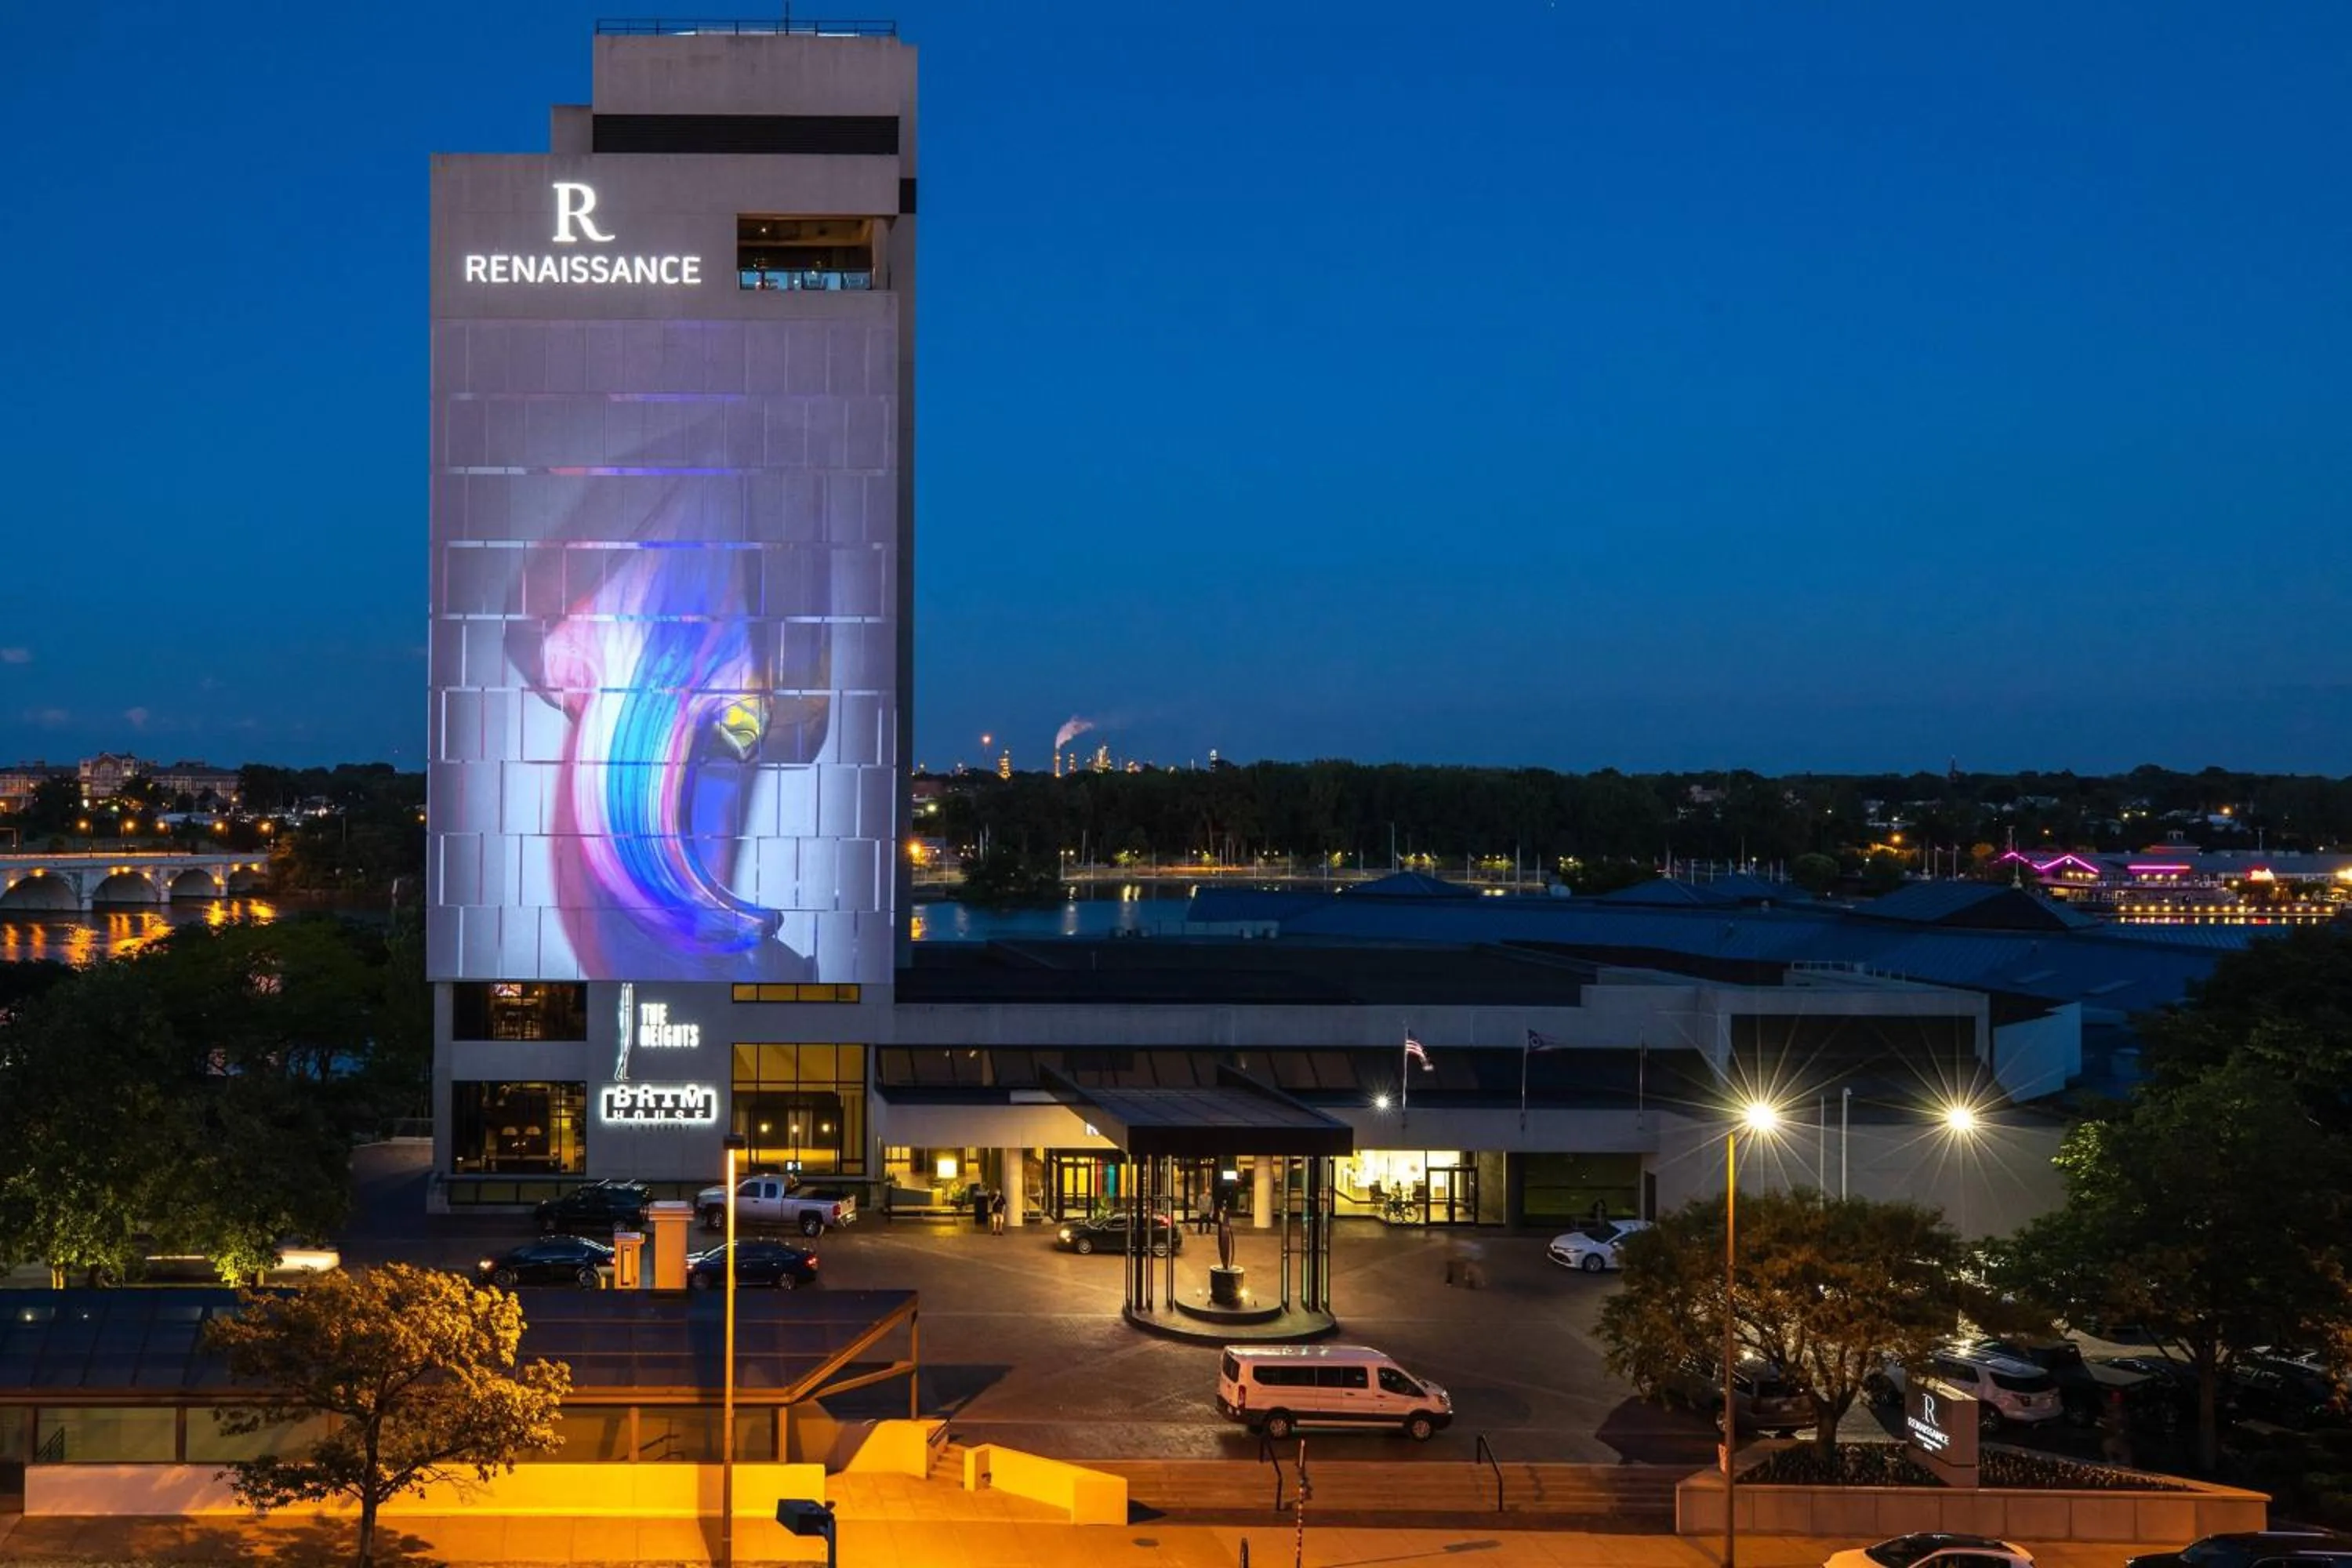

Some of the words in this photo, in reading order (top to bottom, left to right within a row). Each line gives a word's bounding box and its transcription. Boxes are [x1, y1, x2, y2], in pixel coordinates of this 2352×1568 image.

[552, 183, 615, 242] R
[466, 254, 702, 284] RENAISSANCE
[641, 1003, 667, 1025] THE
[639, 1024, 699, 1047] HEIGHTS
[613, 1084, 705, 1108] BRIM
[612, 1109, 705, 1120] HOUSE
[1922, 1393, 1940, 1427] R
